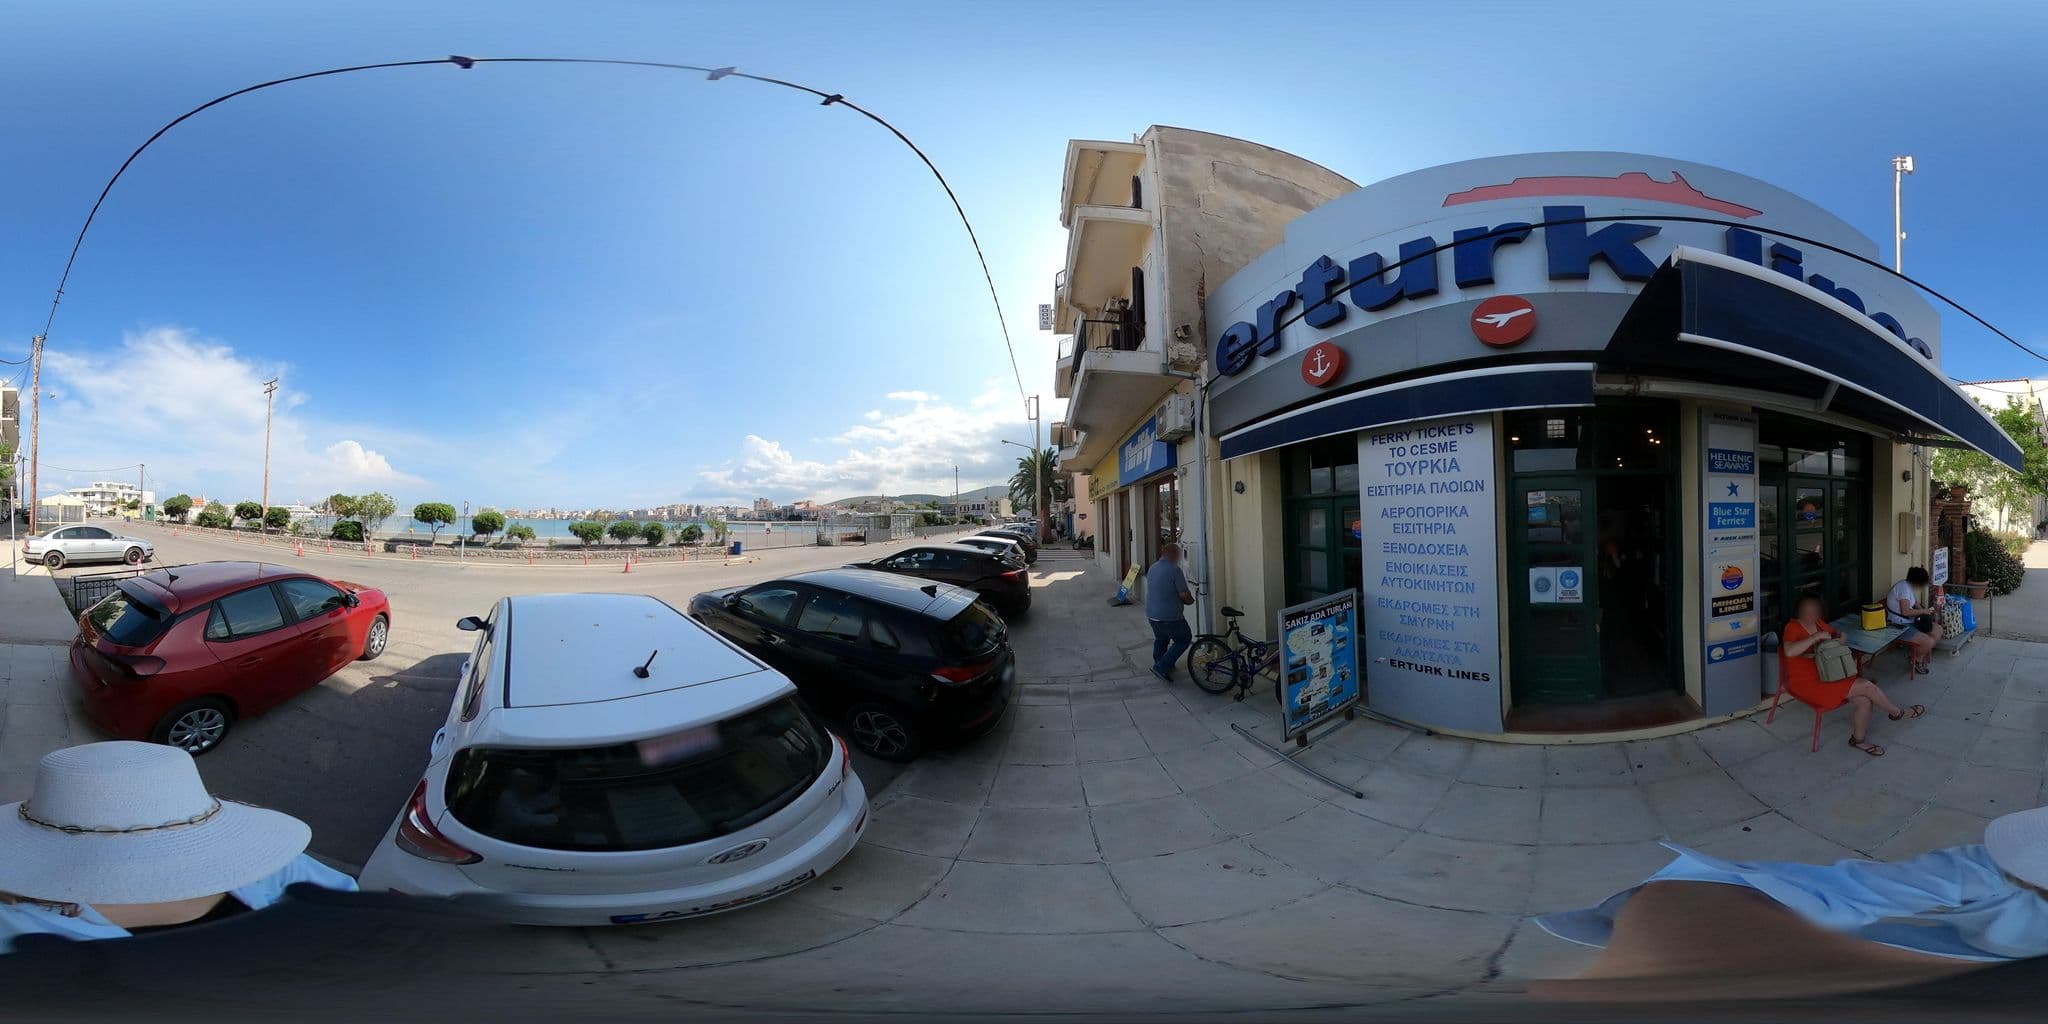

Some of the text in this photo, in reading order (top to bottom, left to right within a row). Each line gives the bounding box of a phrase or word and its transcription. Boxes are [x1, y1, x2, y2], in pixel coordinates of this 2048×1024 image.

[1216, 205, 1663, 376] erturk
[1371, 423, 1474, 446] FERRY TICKETS
[1389, 440, 1458, 458] TO CESME
[1710, 452, 1753, 463] HELLENIC
[1384, 457, 1461, 477] ΤΟΥΡΚΙΑ
[1714, 460, 1750, 471] SEAWAYS
[1367, 480, 1485, 497] ΕΙΣΙΤΗΡΙΑ ΠΛΟΙΩΝ
[1381, 505, 1469, 519] ΑΕΡΟΠΟΡΙΚΑ
[1713, 506, 1752, 516] Blue Star
[1392, 522, 1456, 534] ΕΙΣΙΤΗΡΙΑ
[1717, 517, 1745, 525] Ferries
[1382, 542, 1469, 556] ΞΕΝΟΔΟΧΕΙΑ
[1385, 561, 1469, 577] ΕΝΟΙΚΙΑΣΕΙΣ
[1381, 576, 1475, 593] ΑΥΤΟΚΙΝΗΤΩΝ
[1378, 597, 1480, 618] ΕΚΔΡΟΜΕΣ ΣΤΗ
[1712, 596, 1753, 608] MINOAN
[1718, 603, 1748, 613] LINES
[1285, 615, 1310, 630] SAKIZ
[1310, 610, 1326, 621] ADA
[1399, 614, 1455, 631] ΣΜΥΡΝΗ
[1379, 630, 1480, 654] ΕΚΔΡΟΜΕΣ ΣΤΑ
[1389, 658, 1490, 682] ERTURK LINES
